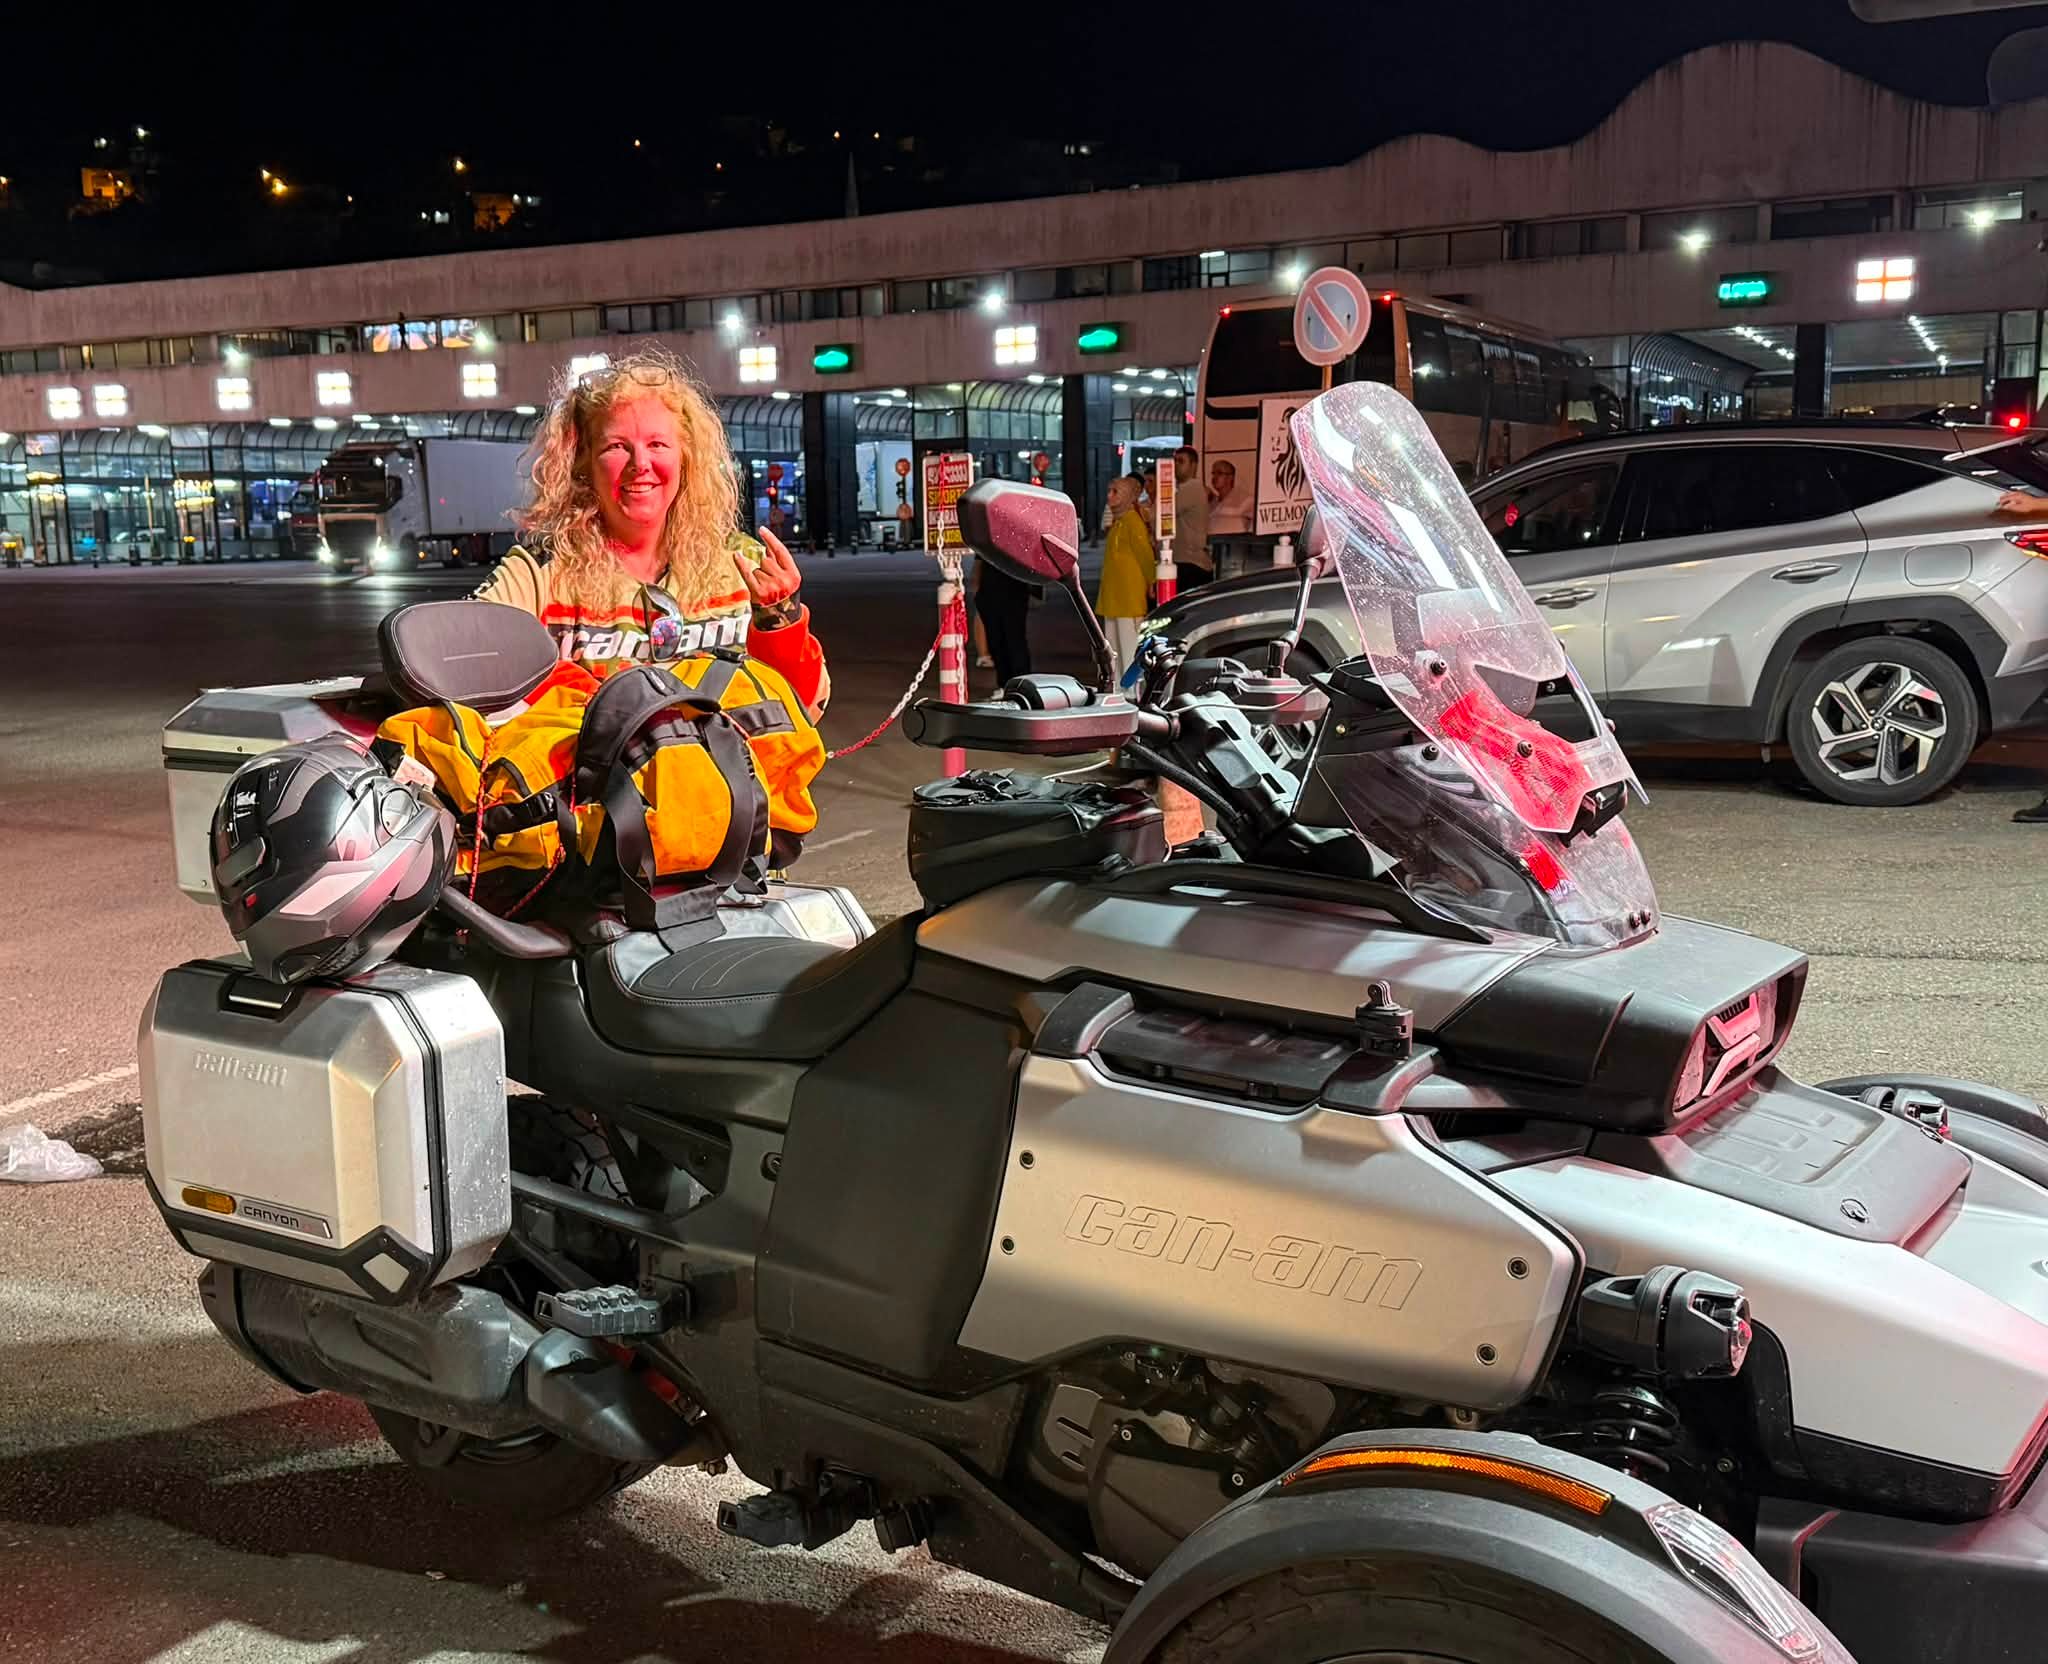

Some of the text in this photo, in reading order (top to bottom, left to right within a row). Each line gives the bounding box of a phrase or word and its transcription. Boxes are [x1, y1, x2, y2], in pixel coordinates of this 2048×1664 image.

[560, 614, 752, 661] canam
[243, 1205, 299, 1228] CANYON
[1064, 1194, 1424, 1311] can-am
